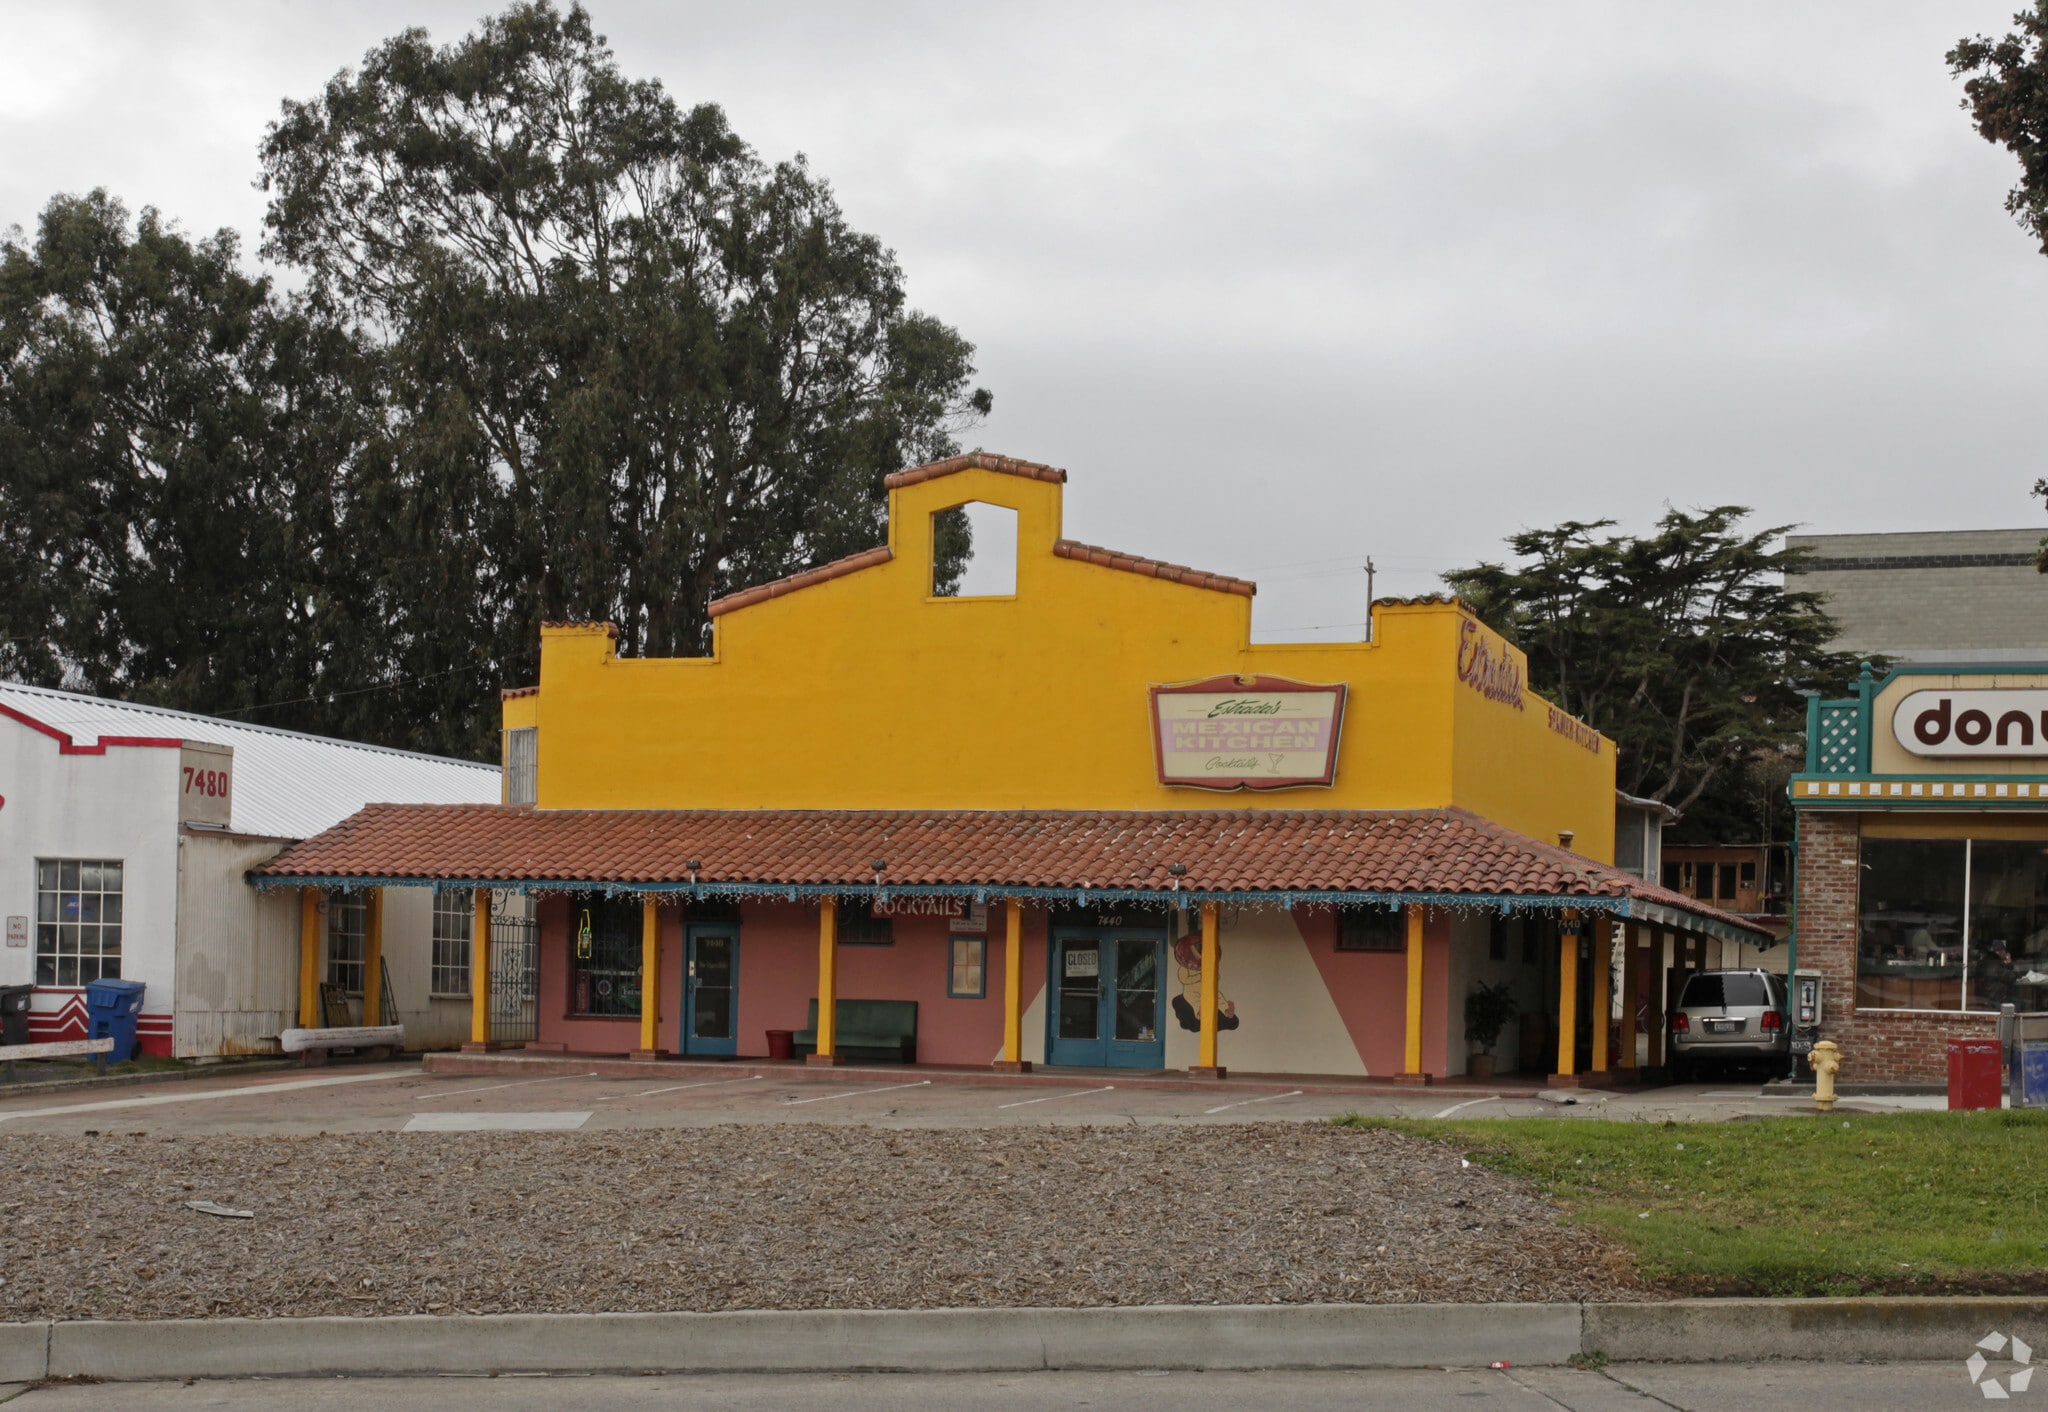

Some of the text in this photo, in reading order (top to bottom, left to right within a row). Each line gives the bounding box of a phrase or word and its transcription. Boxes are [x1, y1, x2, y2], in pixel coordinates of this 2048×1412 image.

[1207, 699, 1282, 719] Estrada's
[1172, 720, 1320, 735] MEXICAN
[1913, 698, 2048, 746] don
[1175, 735, 1317, 749] KITCHEN
[1205, 754, 1260, 771] Cocktails
[183, 766, 228, 798] 7480
[1098, 915, 1123, 926] 7440
[1557, 919, 1580, 929] 7440
[7, 932, 26, 940] PARKING
[1067, 951, 1097, 966] CLOSED
